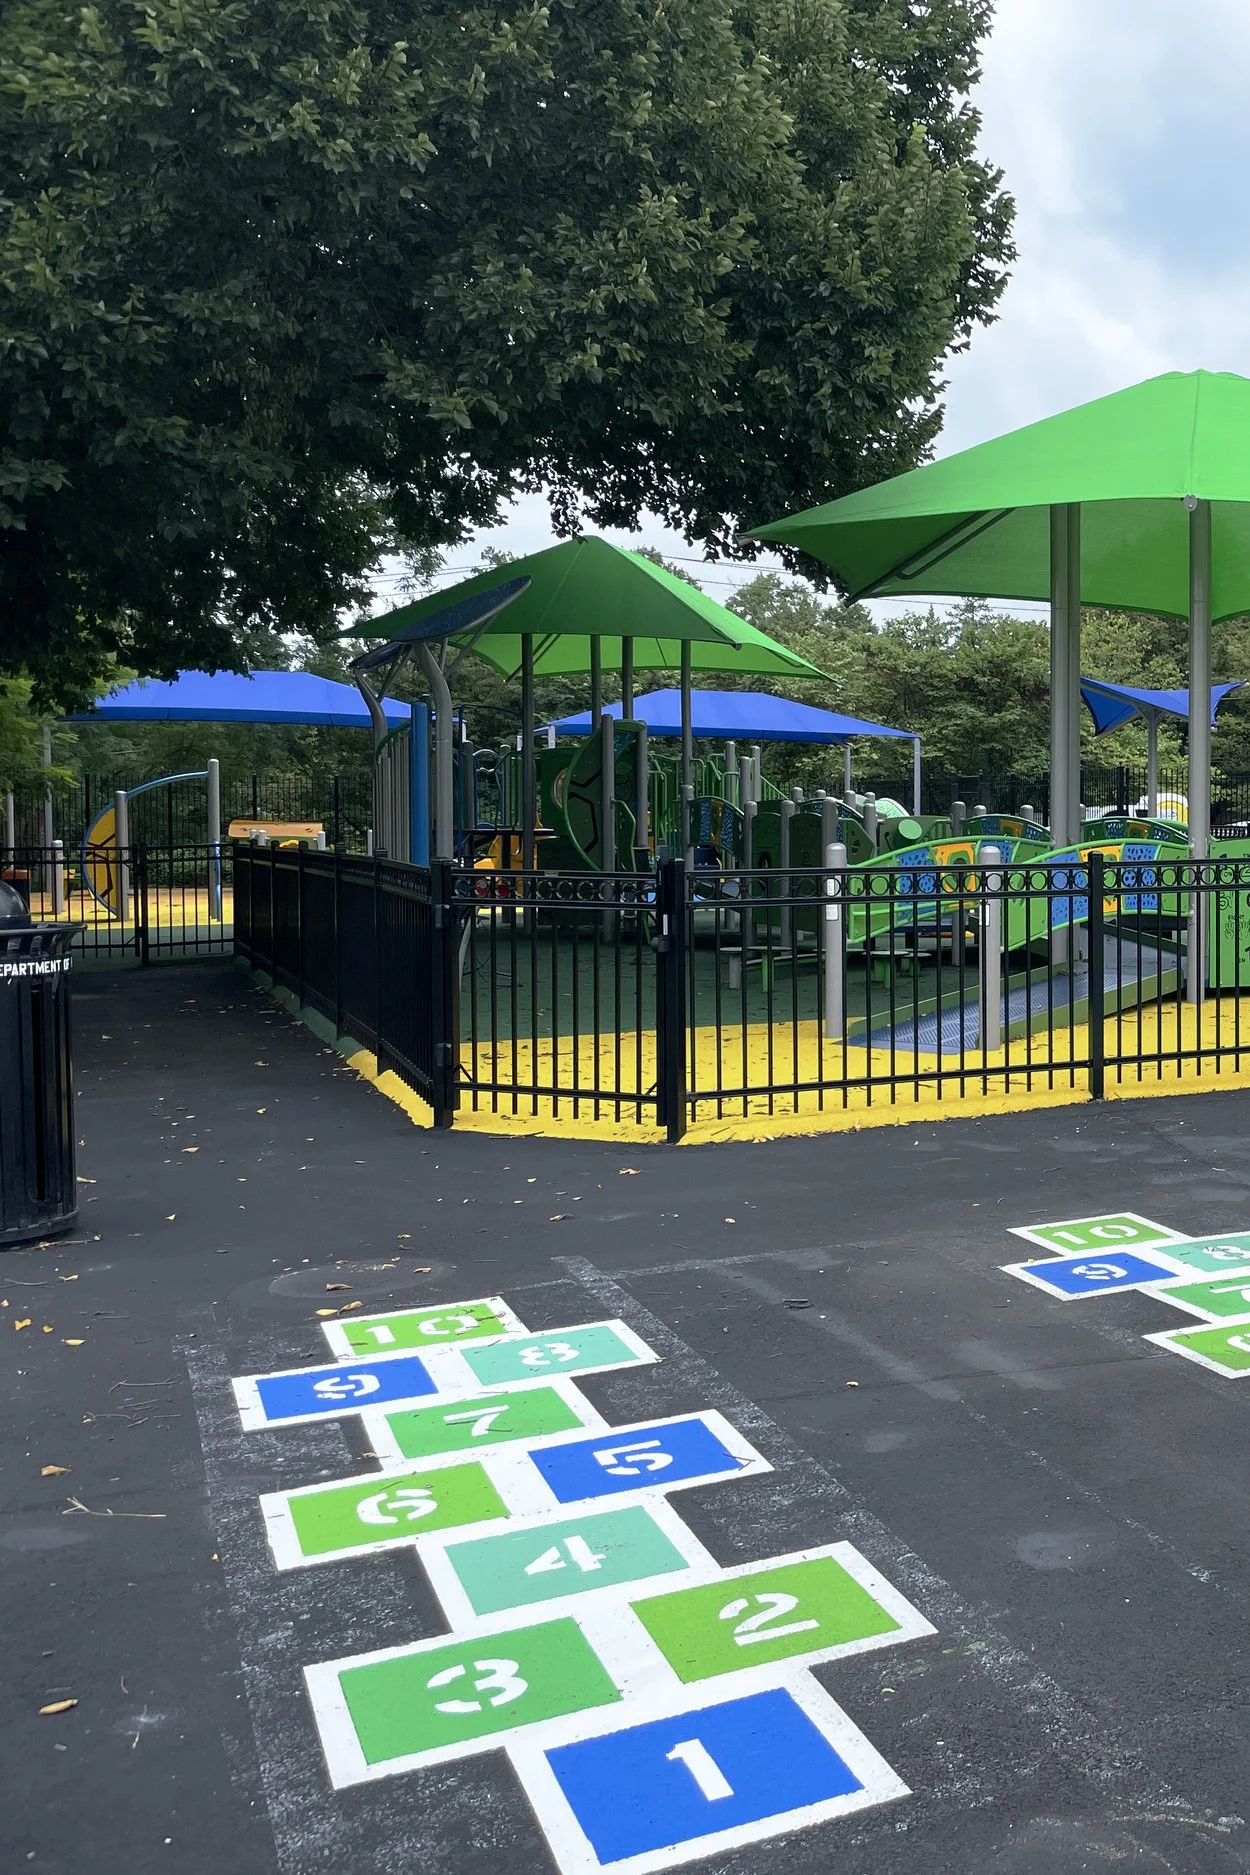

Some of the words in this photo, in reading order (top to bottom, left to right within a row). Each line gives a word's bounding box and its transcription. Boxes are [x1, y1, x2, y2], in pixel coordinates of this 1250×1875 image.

[1051, 1224, 1139, 1246] 10
[1072, 1263, 1128, 1281] 9
[365, 1315, 479, 1345] 10
[517, 1342, 582, 1367] 8
[312, 1373, 381, 1399] 9
[442, 1404, 510, 1437] 7
[592, 1439, 674, 1475] 5
[356, 1488, 438, 1525] 6
[524, 1534, 607, 1575] 4
[719, 1591, 821, 1647] 2
[426, 1658, 529, 1714] 3
[666, 1739, 733, 1802] 1
